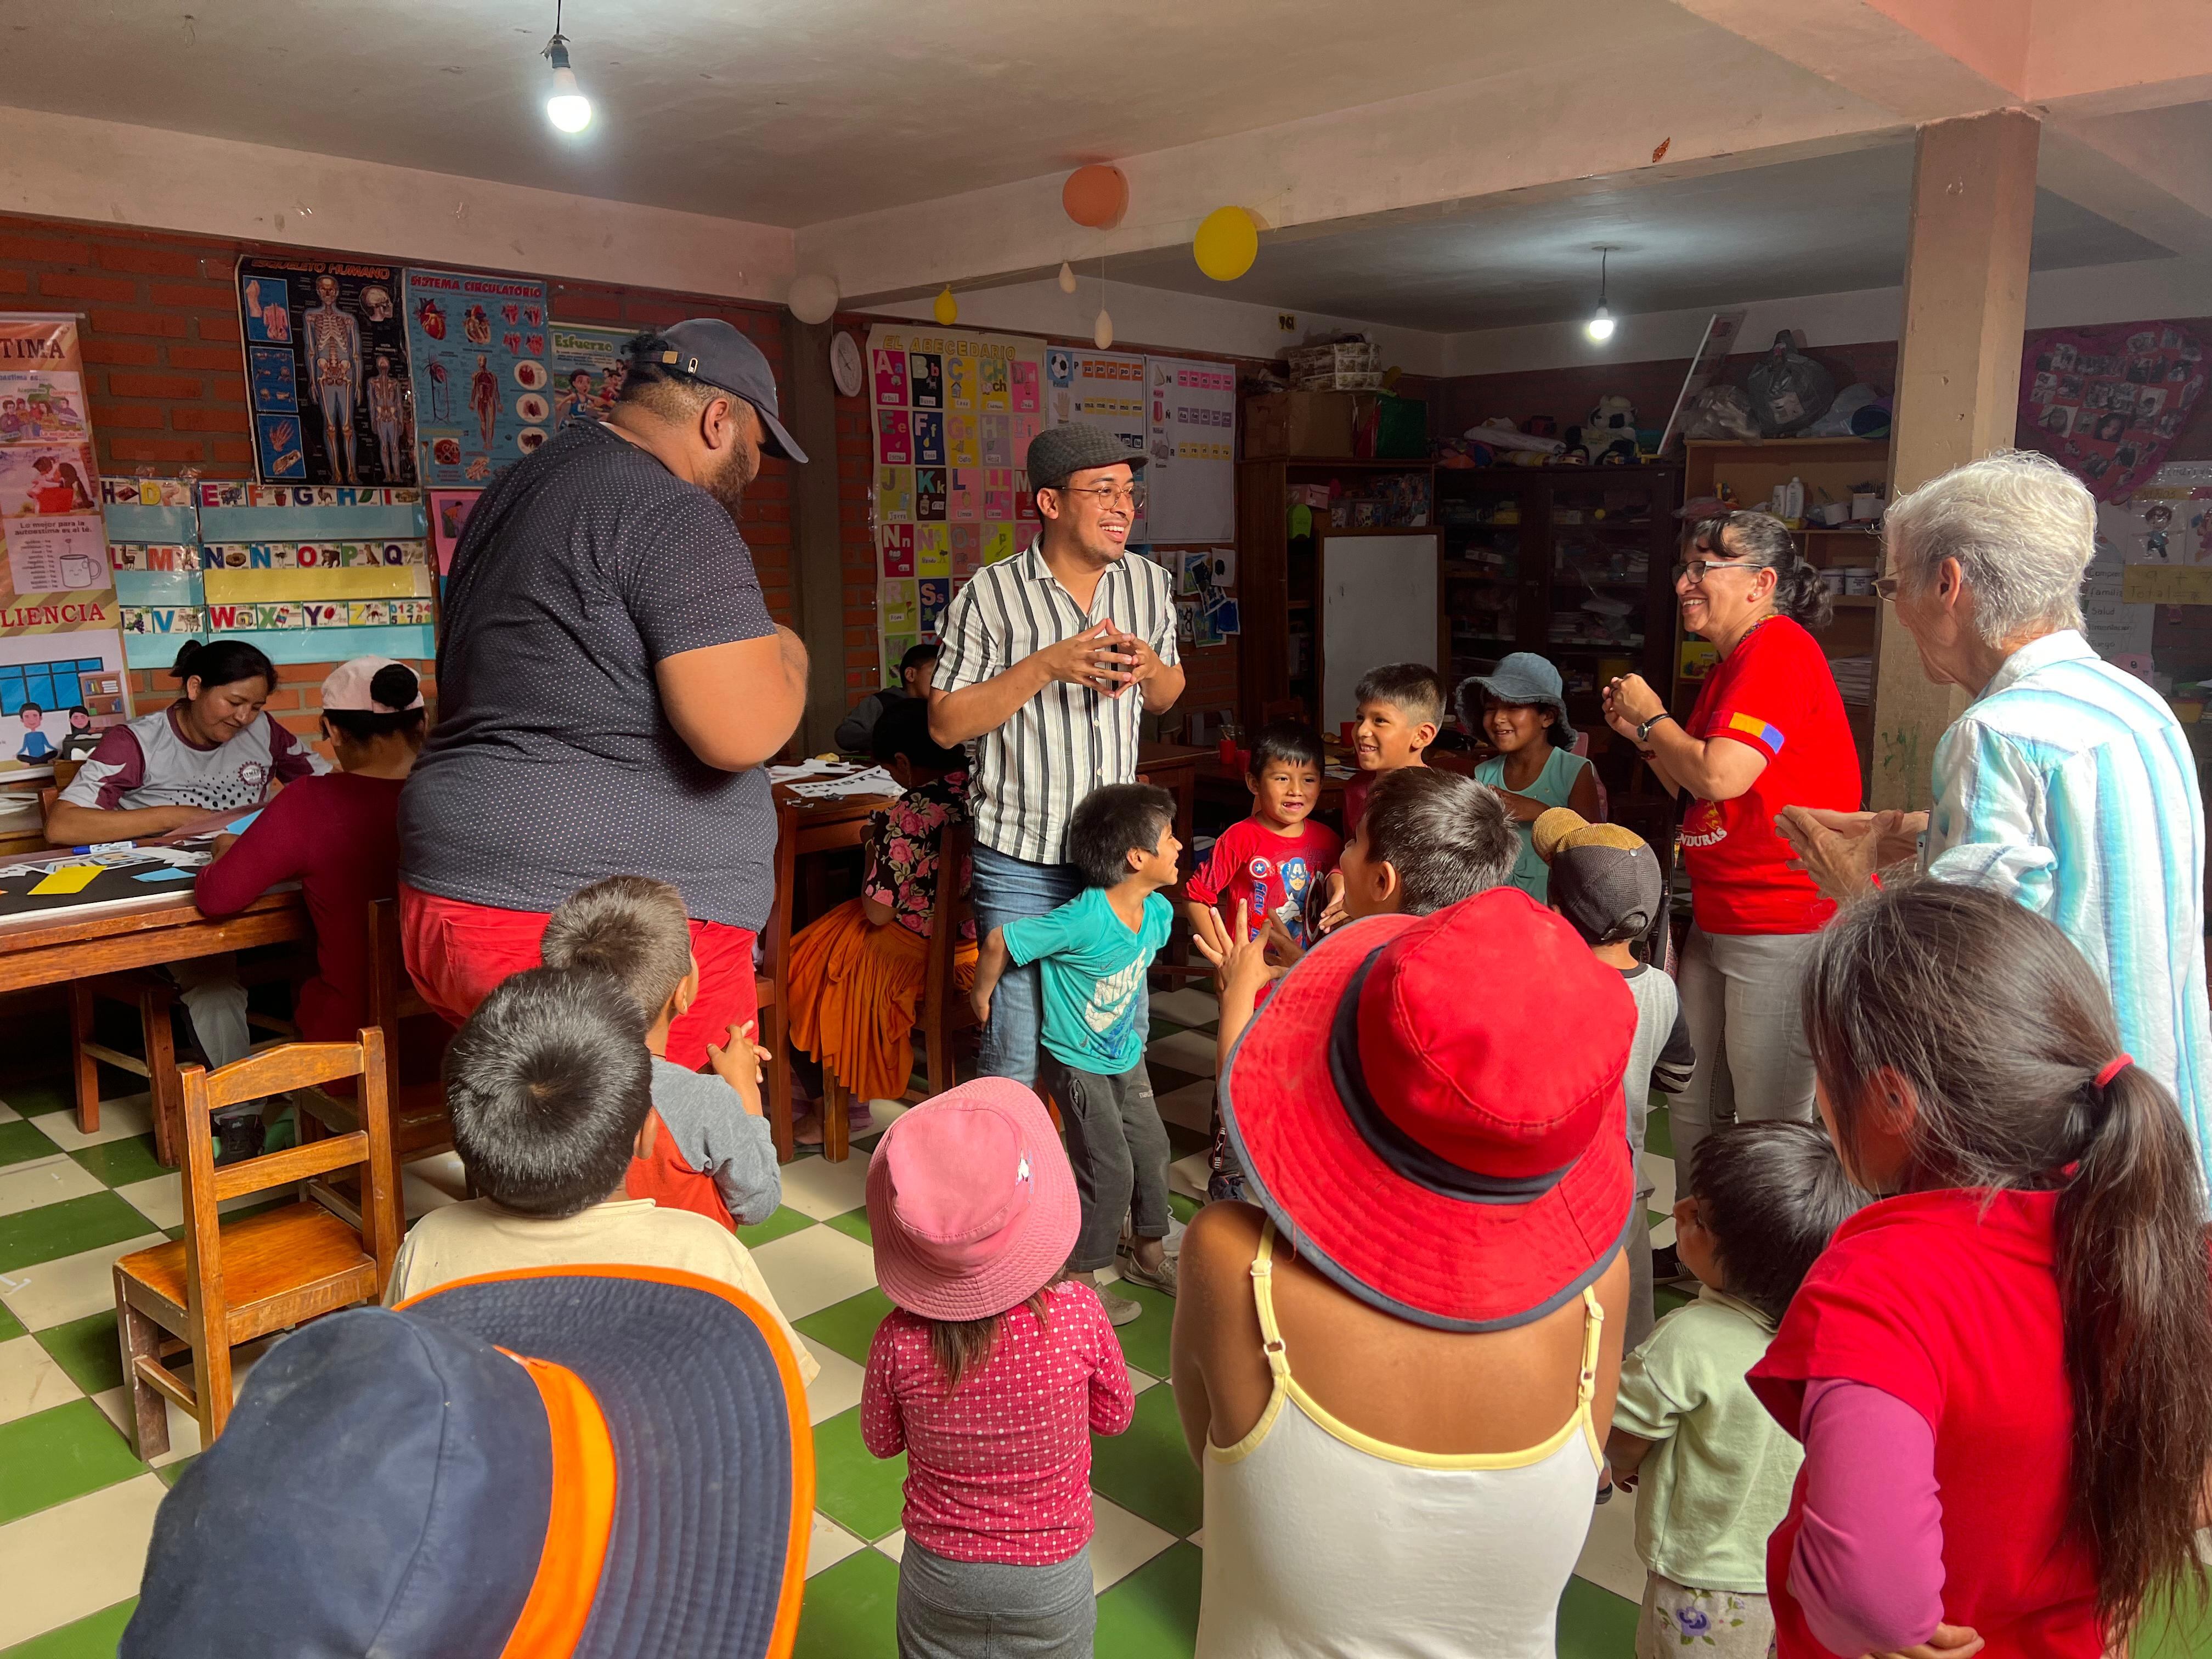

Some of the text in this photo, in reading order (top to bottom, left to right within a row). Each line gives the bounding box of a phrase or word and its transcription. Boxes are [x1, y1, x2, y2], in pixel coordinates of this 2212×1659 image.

[329, 263, 390, 279] HUMANO
[410, 275, 541, 297] SISTEMA CIRCULATORIO
[554, 335, 613, 352] Esfuerzo
[883, 335, 1016, 361] EL ABECEDARIO
[1074, 362, 1079, 370] P
[992, 379, 1007, 392] ch
[1170, 448, 1175, 456] R
[140, 482, 161, 505] D
[202, 485, 219, 506] E
[248, 485, 264, 506] F
[294, 487, 313, 505] G
[337, 488, 357, 505] H
[384, 489, 392, 505] I
[110, 547, 123, 570] L
[148, 548, 173, 571] M
[204, 547, 224, 569] N
[251, 542, 271, 568] Ñ
[297, 546, 317, 567] O
[342, 545, 357, 566] P
[385, 544, 403, 565] Q
[1, 603, 105, 628] LIENCIA
[153, 610, 175, 632] V
[209, 607, 236, 628] W
[257, 606, 278, 628] X
[304, 605, 323, 627] Y
[349, 605, 366, 624] Z
[2091, 607, 2115, 615] Salud
[1254, 879, 1268, 916] Stev
